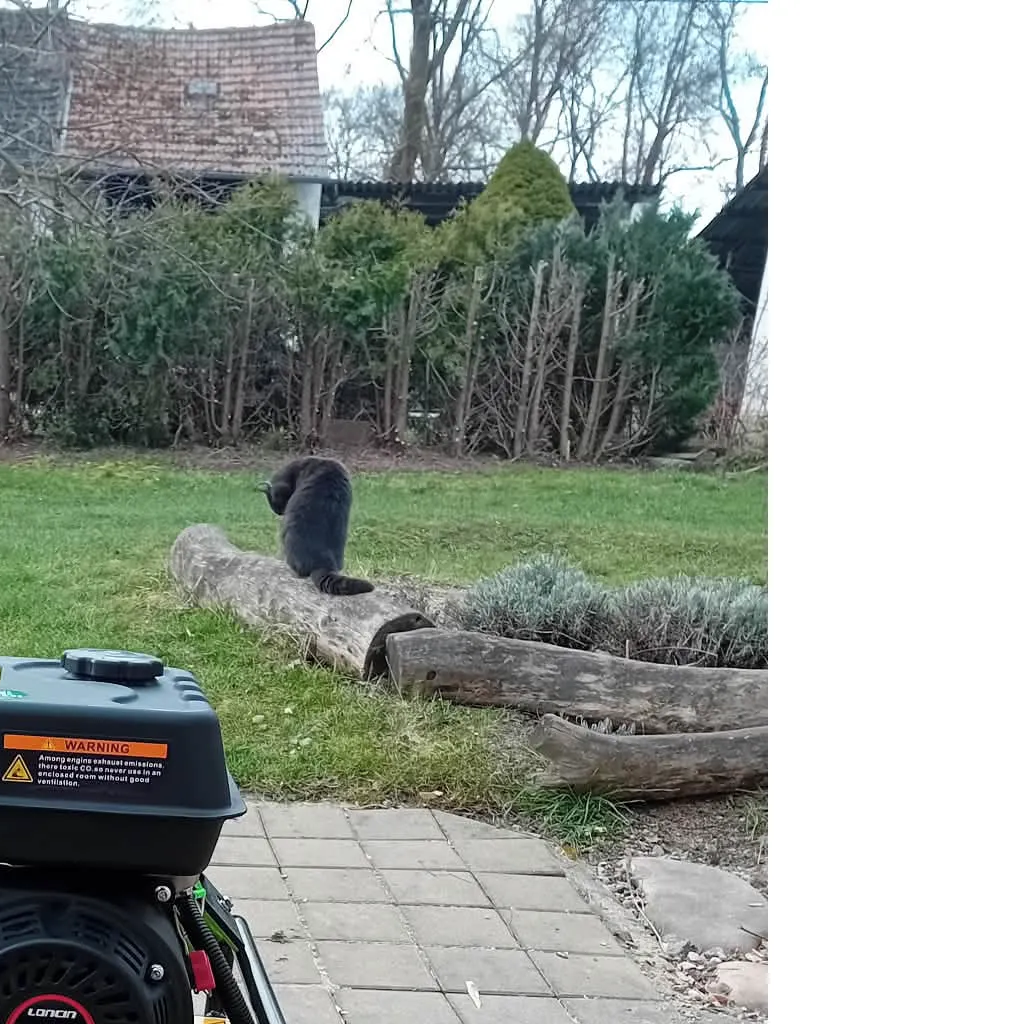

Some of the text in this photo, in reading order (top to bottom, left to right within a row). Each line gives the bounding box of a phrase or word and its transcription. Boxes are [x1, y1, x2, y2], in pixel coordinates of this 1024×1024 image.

[64, 740, 130, 754] WARNING
[38, 755, 66, 764] Among
[66, 756, 92, 765] engine
[38, 770, 74, 779] enclosed
[98, 773, 128, 782] without
